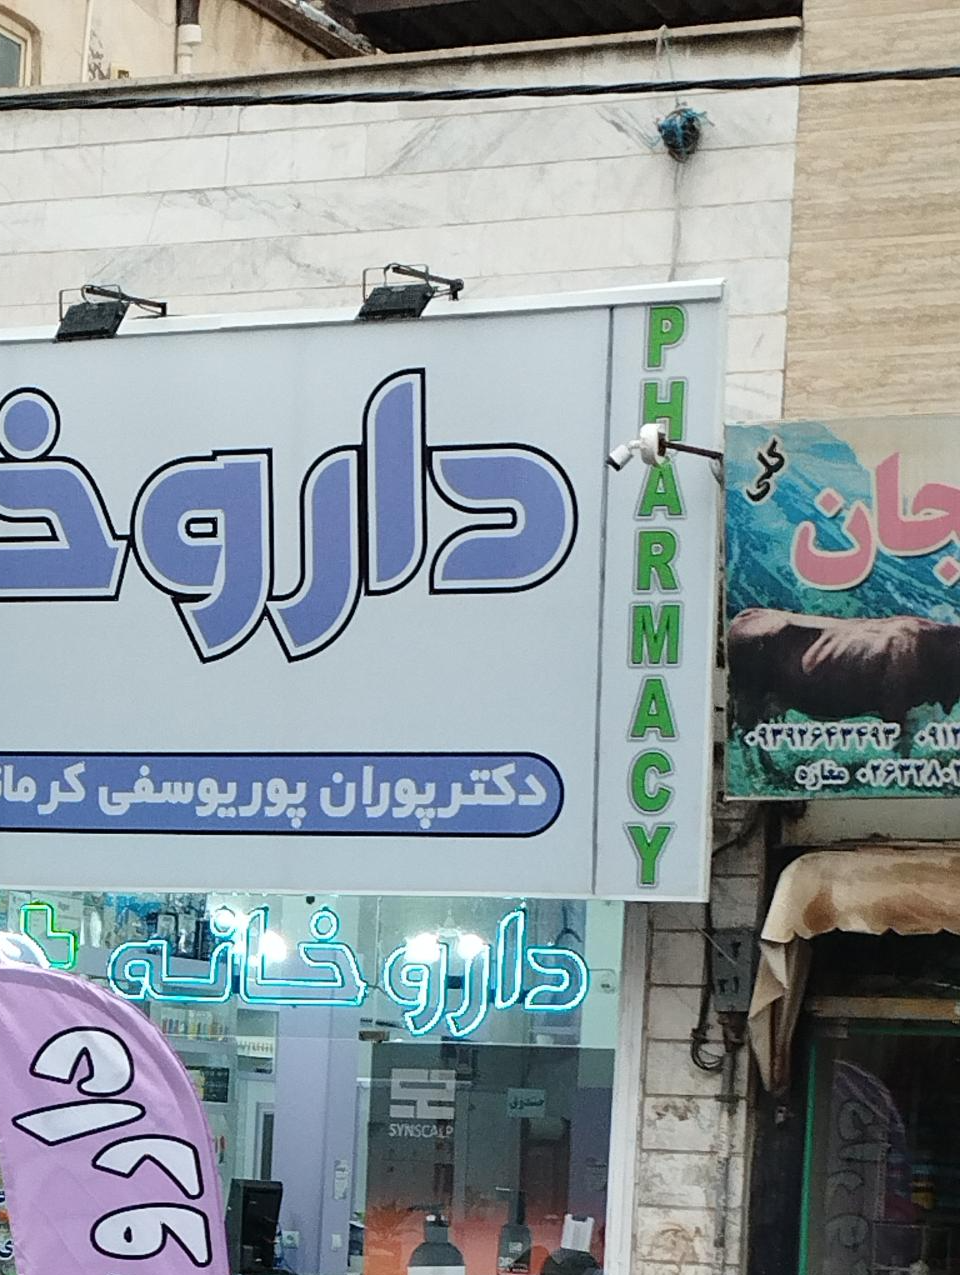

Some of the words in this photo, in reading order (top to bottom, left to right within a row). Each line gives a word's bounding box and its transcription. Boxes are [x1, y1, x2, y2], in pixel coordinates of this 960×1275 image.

[792, 452, 960, 589] جان
[624, 304, 687, 888] PHARMACY
[320, 765, 437, 829] پوران
[437, 762, 548, 818] دکتر
[107, 905, 590, 1038] داروخانه
[389, 1122, 454, 1139] SYNSCALP
